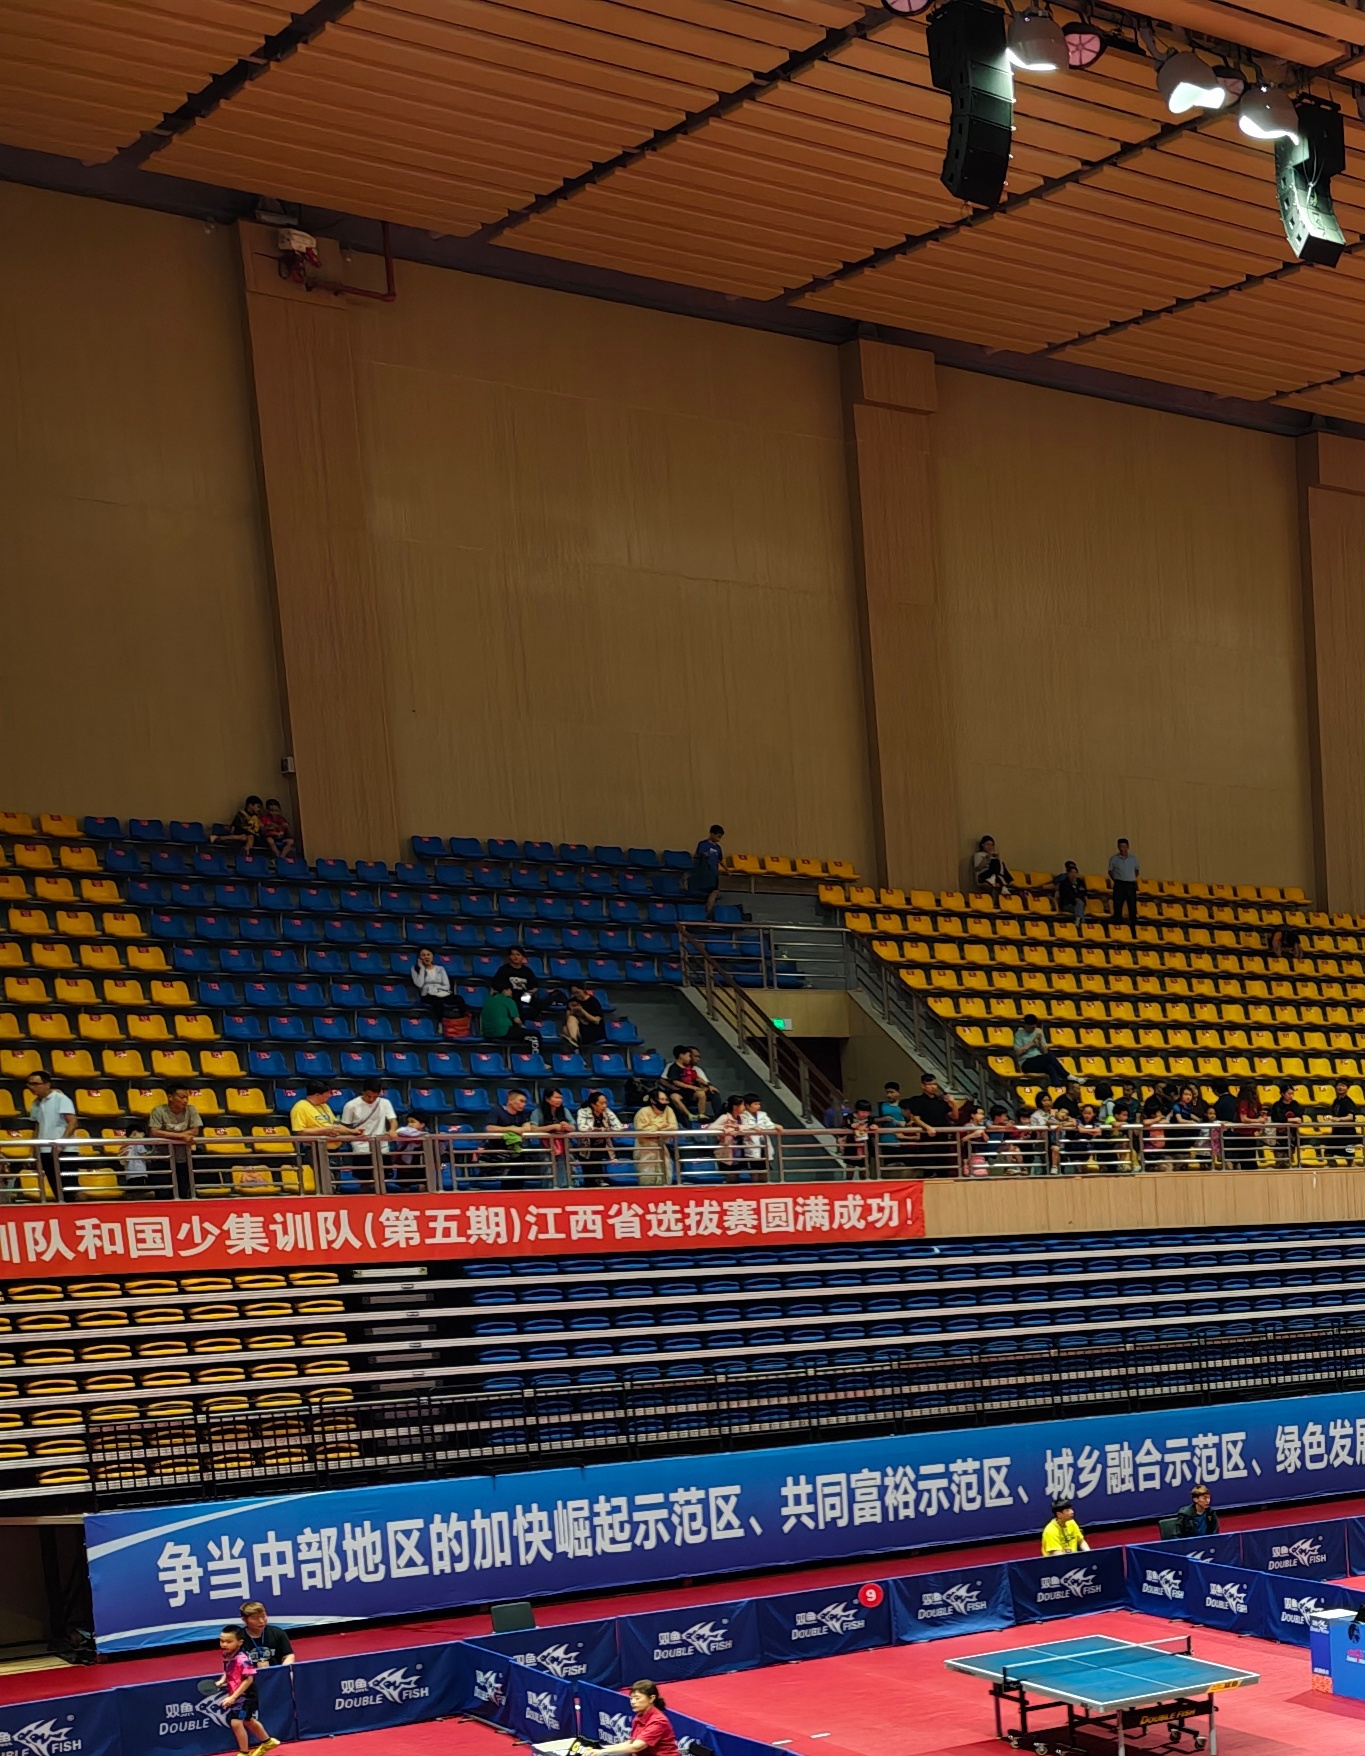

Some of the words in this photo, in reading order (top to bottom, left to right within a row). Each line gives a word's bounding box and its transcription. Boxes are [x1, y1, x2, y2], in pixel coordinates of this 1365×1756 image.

[865, 1589, 877, 1602] 9
[1036, 1589, 1071, 1602] DOUBLE
[1083, 1584, 1101, 1595] FISH
[791, 1625, 828, 1640] DOUBLE
[843, 1620, 865, 1631] FISH
[654, 1646, 694, 1660] DOUBLE
[710, 1640, 732, 1652] FISH
[335, 1694, 383, 1710] DOUBLE
[402, 1687, 429, 1700] FISH
[1140, 1711, 1175, 1725] DOUBLE
[1177, 1708, 1196, 1719] FISH
